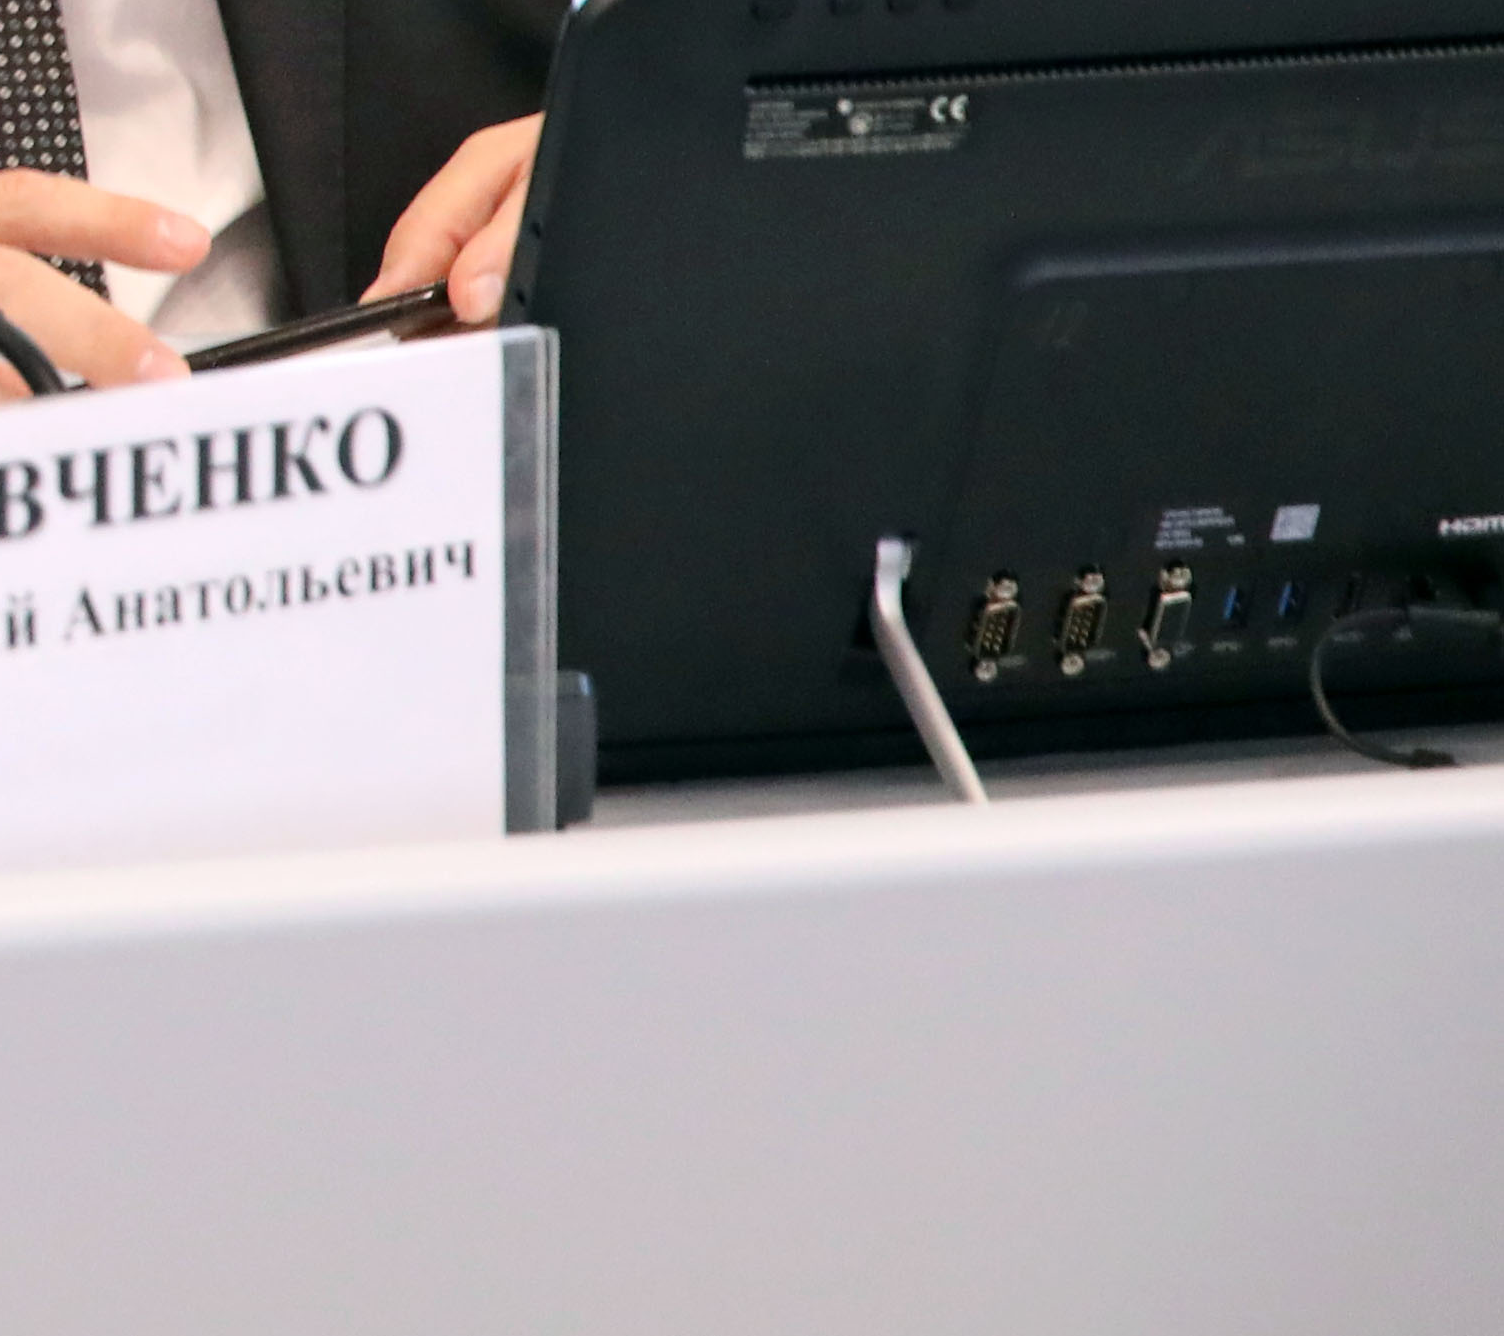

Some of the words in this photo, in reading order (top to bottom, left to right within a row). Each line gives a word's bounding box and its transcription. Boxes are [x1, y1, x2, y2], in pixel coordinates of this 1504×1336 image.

[930, 94, 969, 123] CE
[1438, 515, 1504, 536] HDM
[63, 539, 478, 642] Анатольевич
